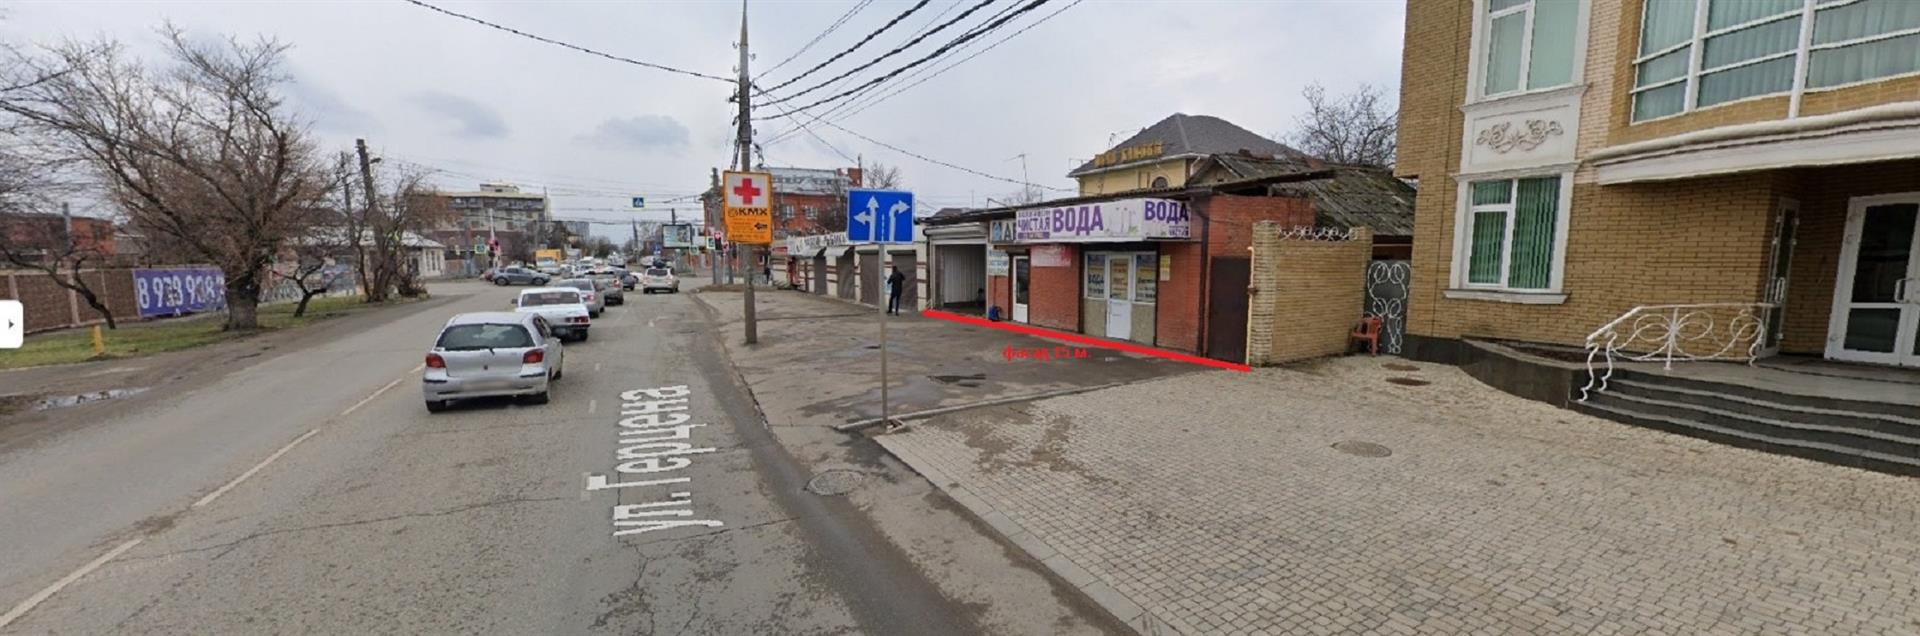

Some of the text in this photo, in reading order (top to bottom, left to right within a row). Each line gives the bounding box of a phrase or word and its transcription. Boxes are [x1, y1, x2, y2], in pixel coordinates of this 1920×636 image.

[1018, 217, 1050, 231] ЧИСТАЯ
[1053, 206, 1103, 236] ВОДА
[1144, 201, 1189, 224] ВОДА
[138, 277, 150, 309] 8
